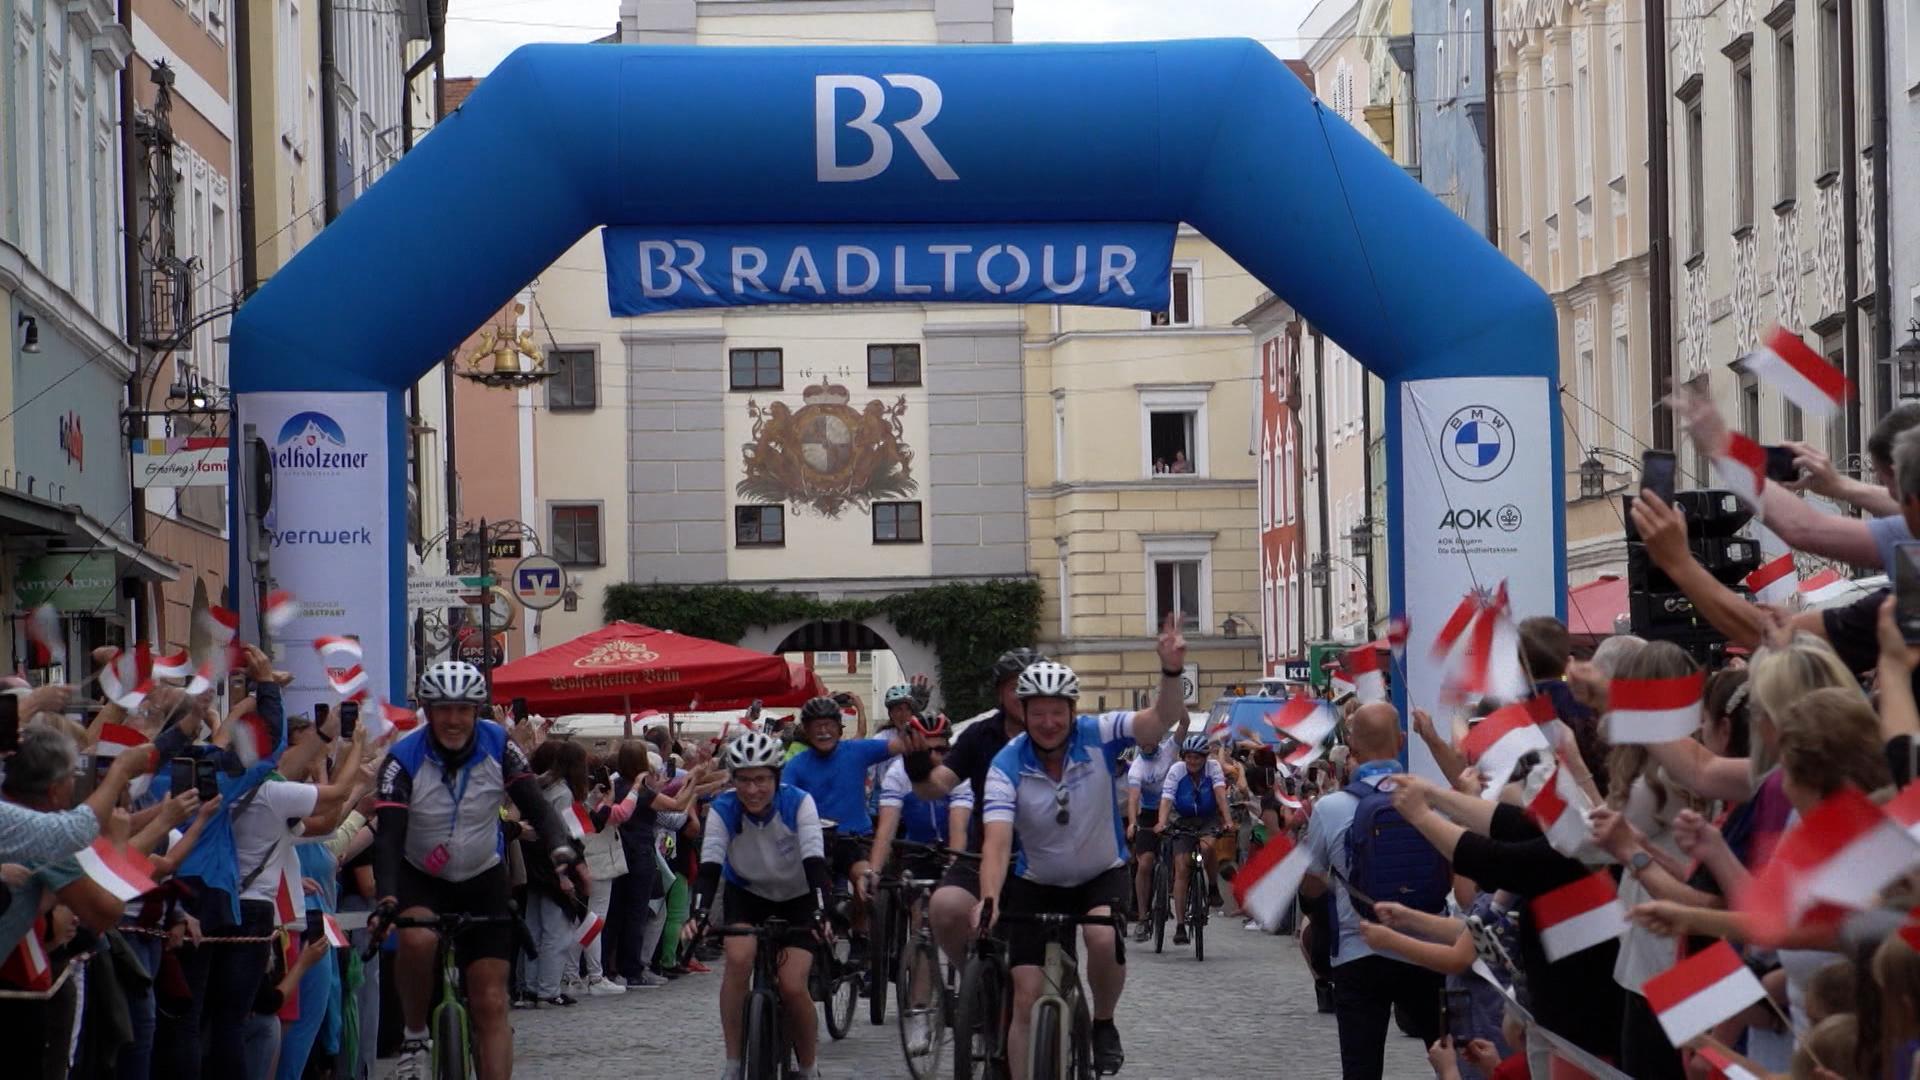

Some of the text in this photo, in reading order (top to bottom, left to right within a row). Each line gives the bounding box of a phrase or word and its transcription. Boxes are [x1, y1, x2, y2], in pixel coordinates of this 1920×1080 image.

[815, 73, 960, 182] BR
[639, 239, 1137, 299] BR RADLTOUR
[1450, 409, 1505, 431] BMW
[197, 459, 229, 473] fami
[1438, 509, 1493, 530] AOK
[272, 526, 372, 548] yernwerk
[462, 647, 498, 656] SPOT
